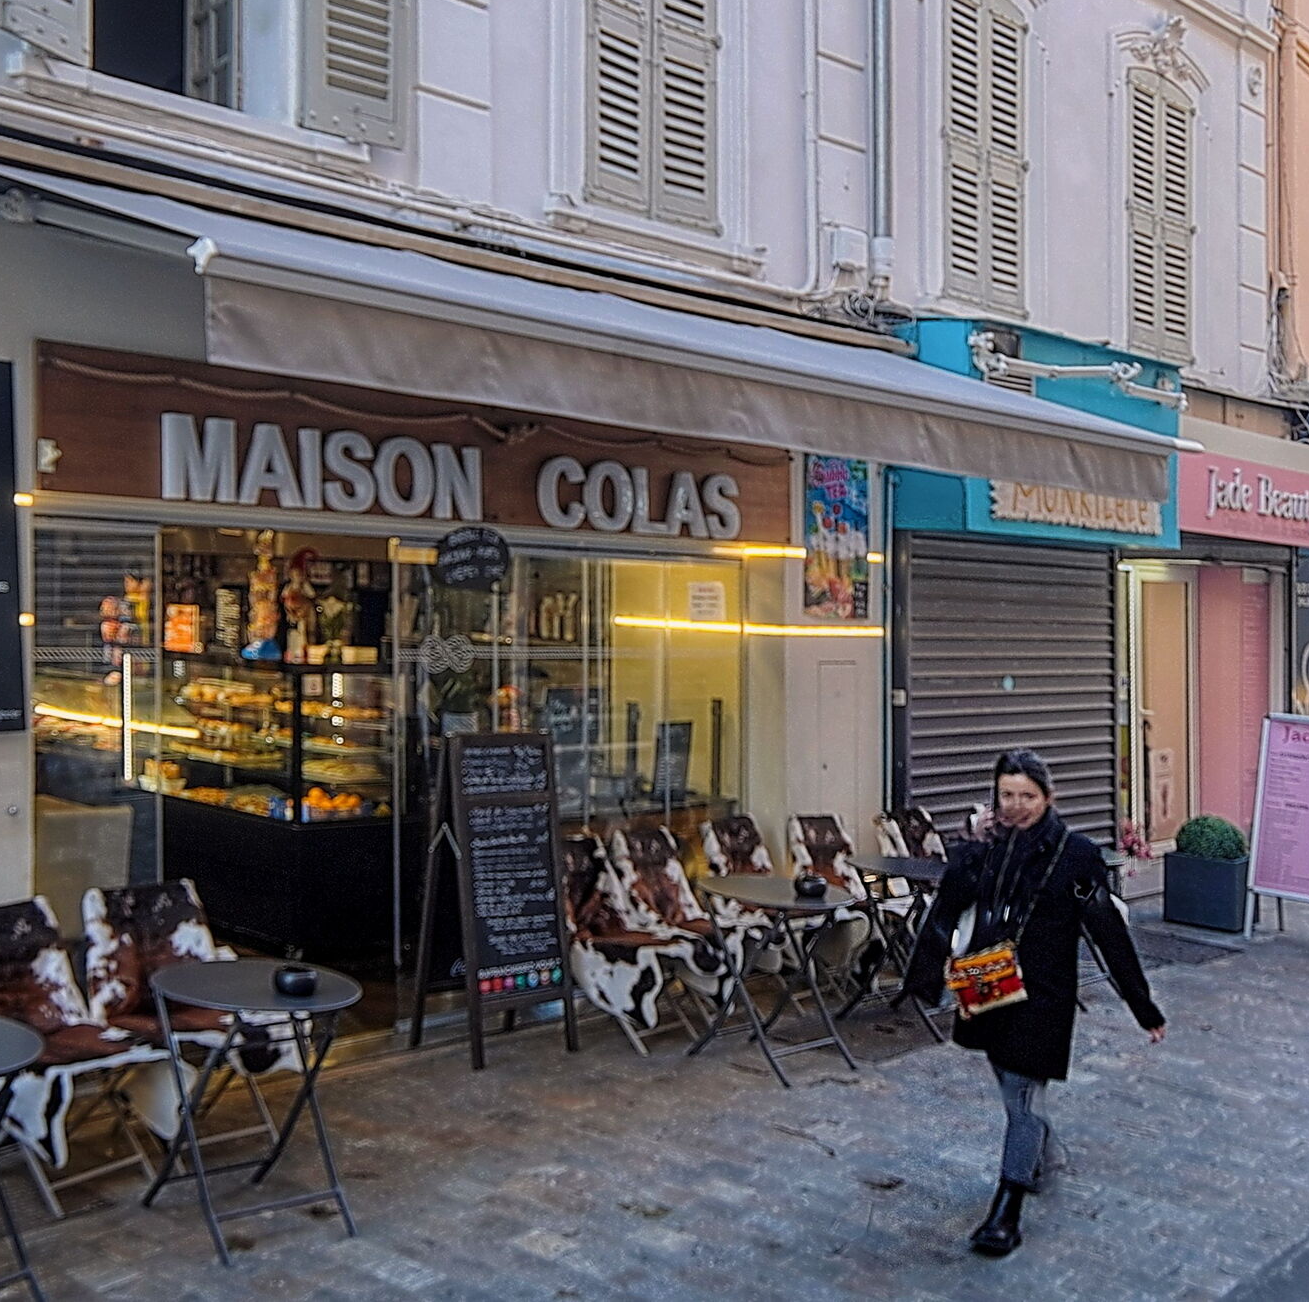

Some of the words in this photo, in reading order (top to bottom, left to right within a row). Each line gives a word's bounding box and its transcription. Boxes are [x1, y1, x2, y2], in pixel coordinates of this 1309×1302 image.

[160, 411, 484, 523] MAISON
[536, 455, 742, 540] COLAS
[1205, 465, 1253, 519] Jade
